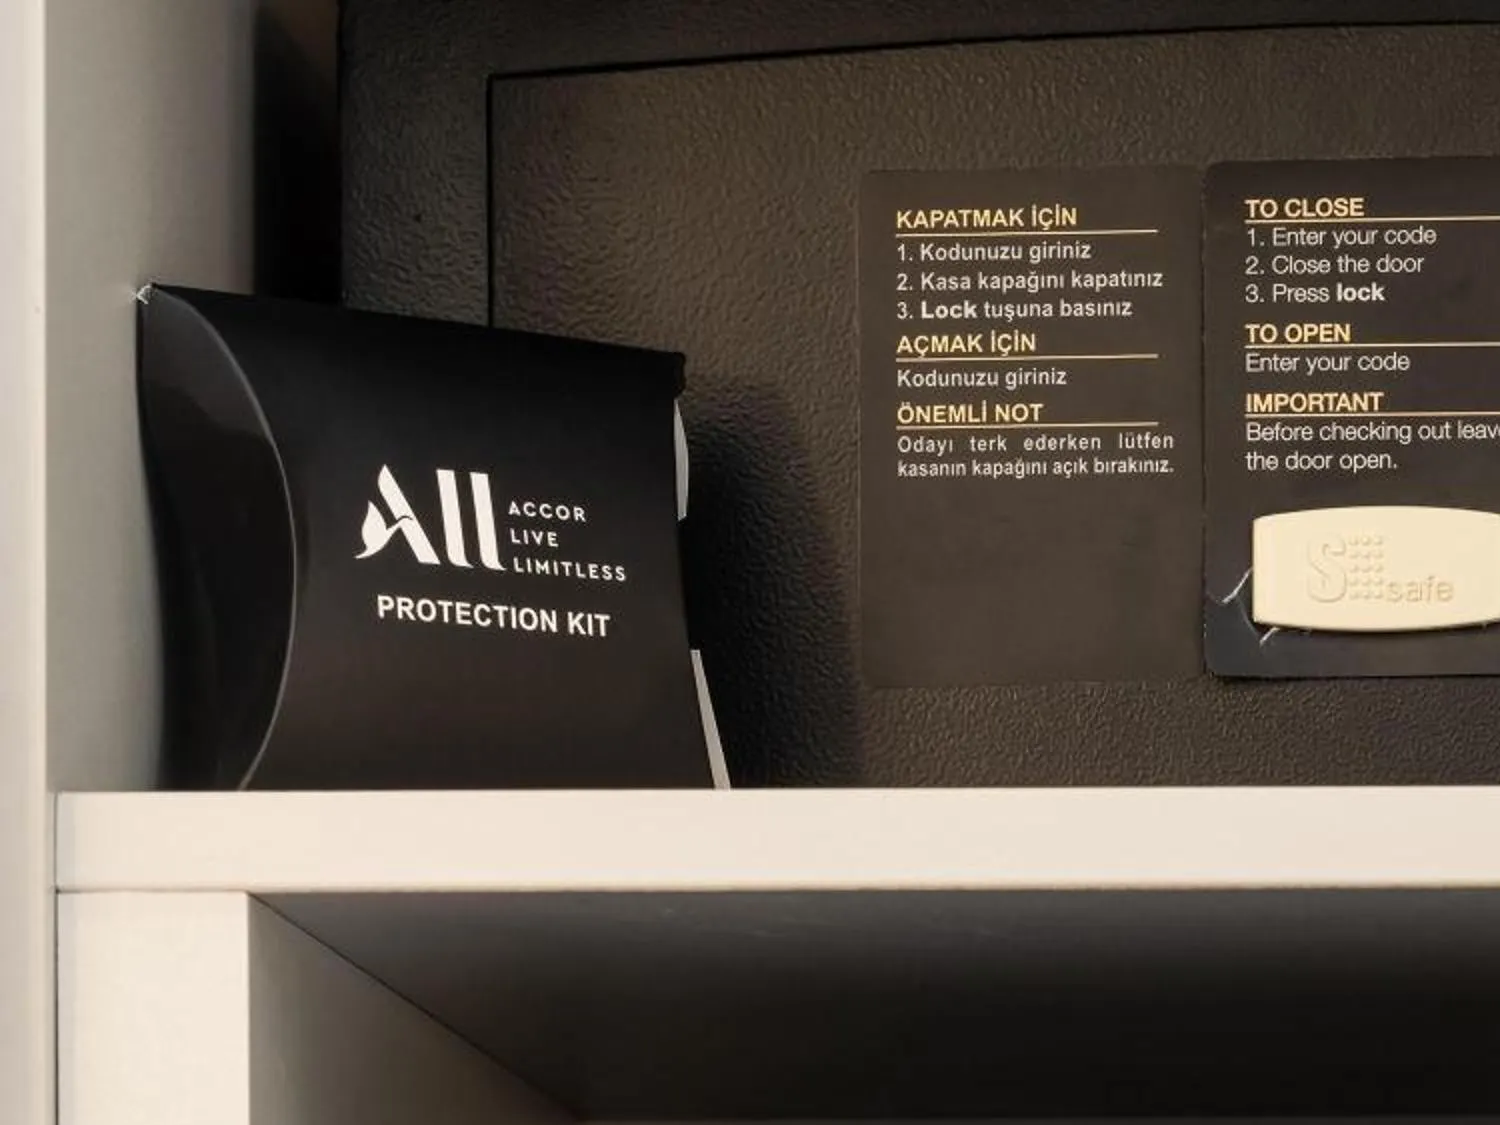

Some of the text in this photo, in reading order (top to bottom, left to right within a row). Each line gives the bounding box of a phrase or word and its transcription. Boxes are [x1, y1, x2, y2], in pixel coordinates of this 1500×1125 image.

[896, 204, 1077, 230] KAPATMAK İÇİN
[1245, 197, 1365, 218] TO CLOSE
[1247, 226, 1437, 249] 1. Enter your code
[897, 241, 1092, 264] 1. Kodunuzu giriniz
[1245, 253, 1424, 276] 2. Close the door
[896, 270, 1163, 293] 2. Kasa kapağını kapatınız
[1245, 282, 1386, 303] 3. Press lock
[896, 299, 1133, 322] 3. Lock tuşuna basınız
[896, 329, 1036, 357] AÇMAK İÇİN
[1245, 323, 1352, 343] TO OPEN
[1245, 352, 1411, 376] Enter your code
[896, 368, 1068, 391] Kodunuzu giriniz
[897, 401, 1044, 424] ÖNEMLİ NOT
[1246, 392, 1384, 413] IMPORTANT
[897, 432, 1174, 457] Odayı terk ederken lütfen
[1246, 422, 1314, 441] Before
[1319, 422, 1412, 444] checking
[1418, 423, 1453, 440] out
[897, 457, 1175, 478] kasanın kapağını açık bırakınız.
[1246, 451, 1398, 474] the door open.
[507, 500, 588, 523] ACCOR
[509, 527, 560, 548] LIVE
[514, 559, 628, 582] LIMITLESS
[1386, 576, 1455, 603] safe
[376, 594, 611, 639] PROTECTION KIT
